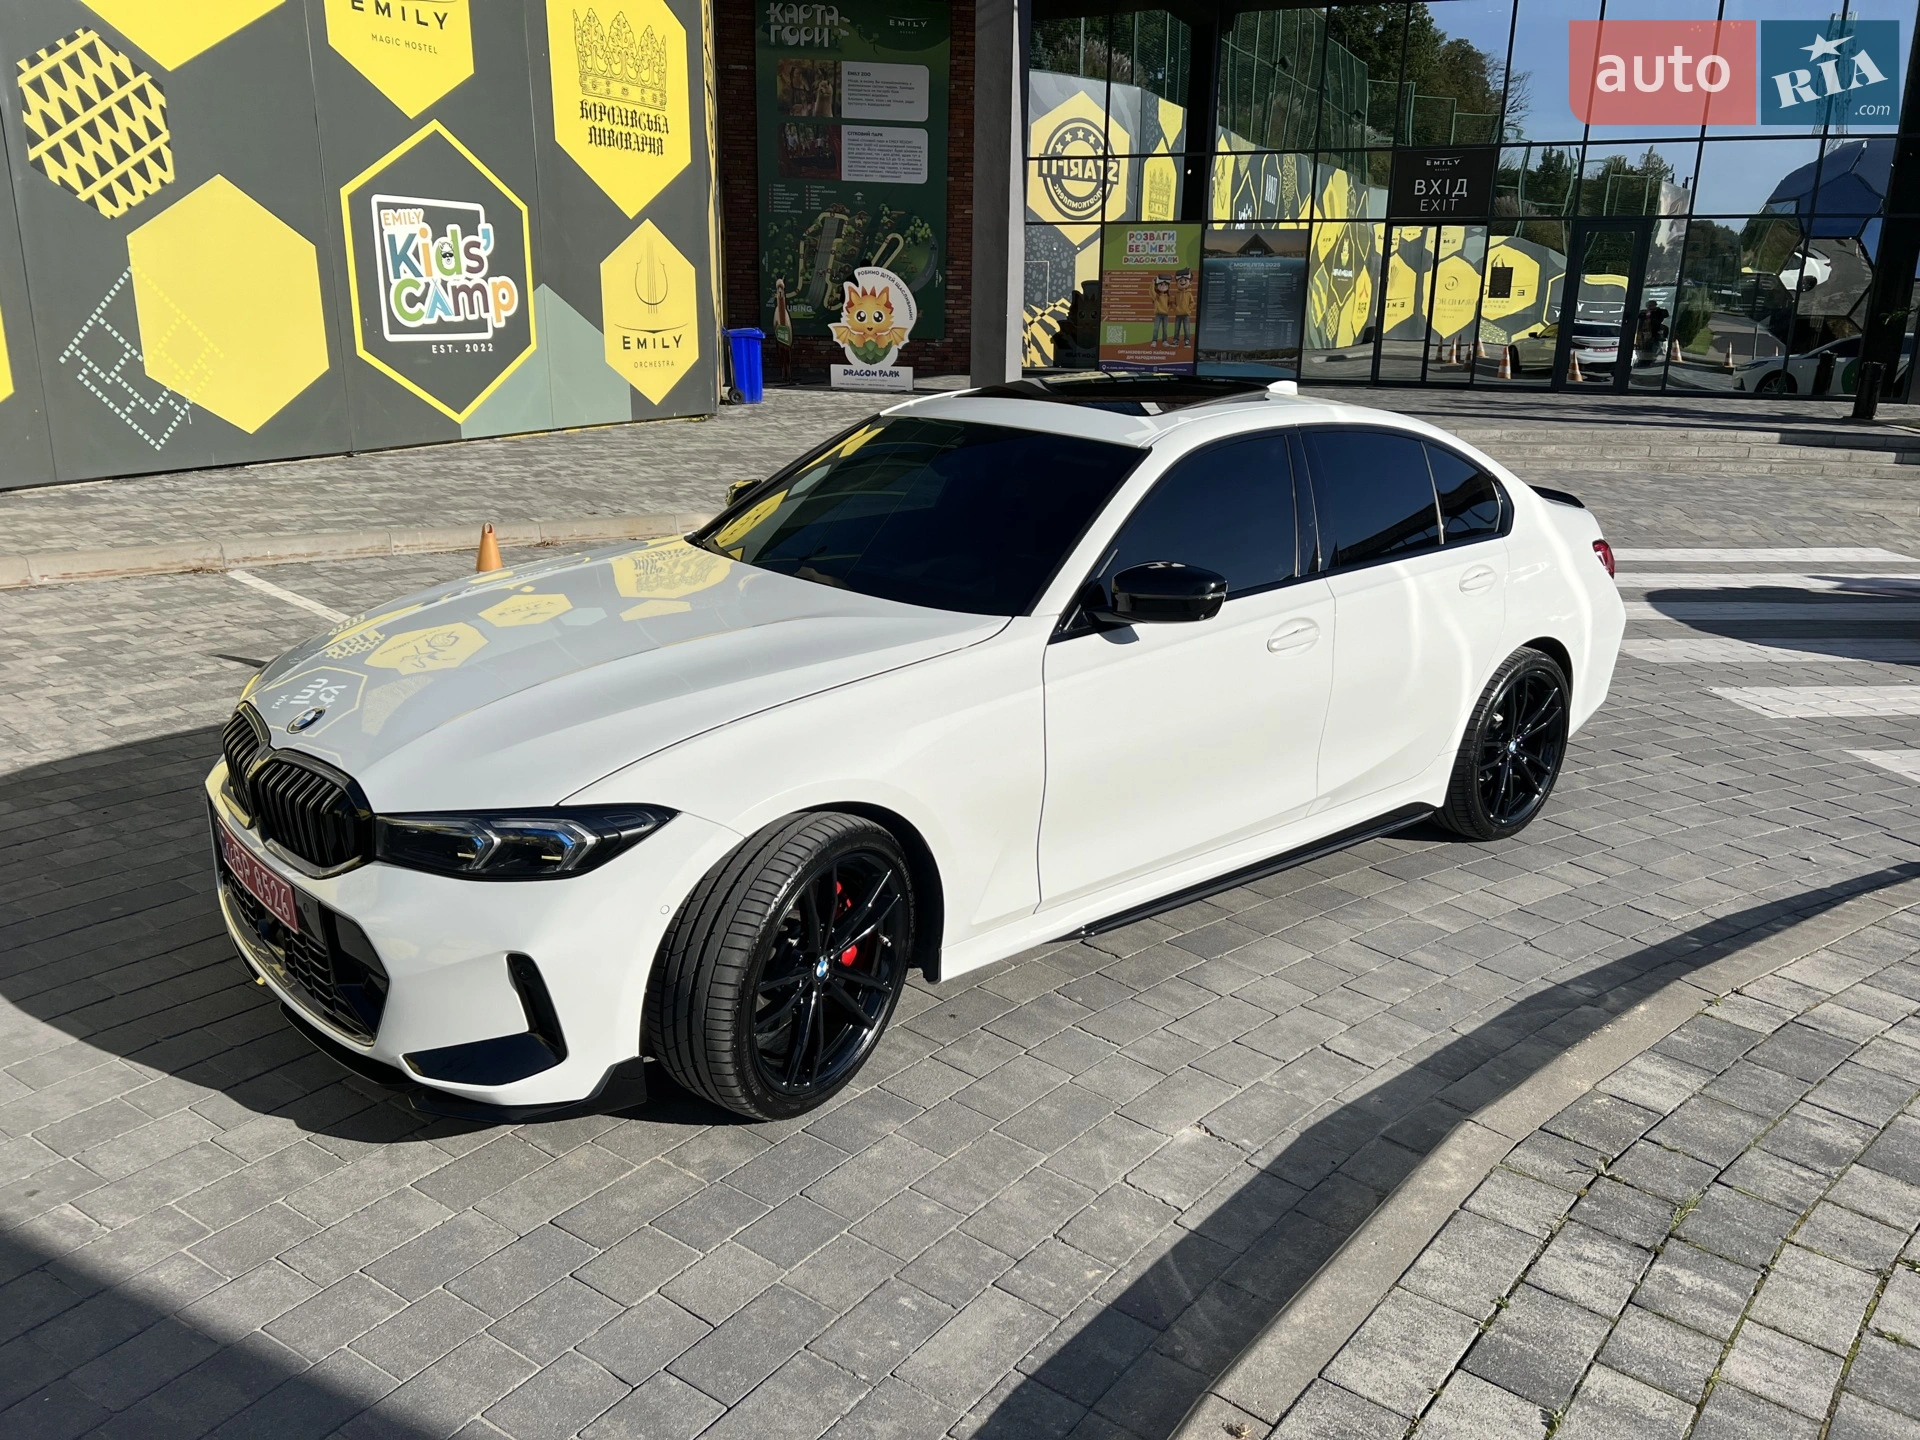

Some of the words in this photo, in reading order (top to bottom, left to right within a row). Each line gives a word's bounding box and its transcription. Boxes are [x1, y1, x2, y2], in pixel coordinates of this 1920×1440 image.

[351, 0, 448, 30] EMILY
[769, 2, 839, 26] КАРТА
[889, 19, 928, 28] EMILY
[769, 25, 829, 48] ГОРИ
[371, 33, 401, 47] MAGIC
[405, 40, 438, 55] HOSTEL
[1414, 178, 1468, 198] ВХІД
[1420, 199, 1459, 212] EXIT
[382, 211, 423, 226] EMILY
[1128, 232, 1175, 242] РОЗВАГИ
[1128, 244, 1147, 253] БЕЗ
[1150, 244, 1175, 253] МЕЖ
[1123, 256, 1157, 264] DRAGON
[1158, 255, 1178, 263] PARK
[880, 272, 896, 283] ДІТЕЙ
[432, 344, 459, 354] EST.
[465, 343, 494, 353] 2022
[622, 334, 682, 350] EMILY
[634, 360, 675, 369] ORCHESTRA
[843, 369, 877, 377] DRAGON
[878, 370, 900, 378] PARK
[254, 866, 290, 921] 8526
